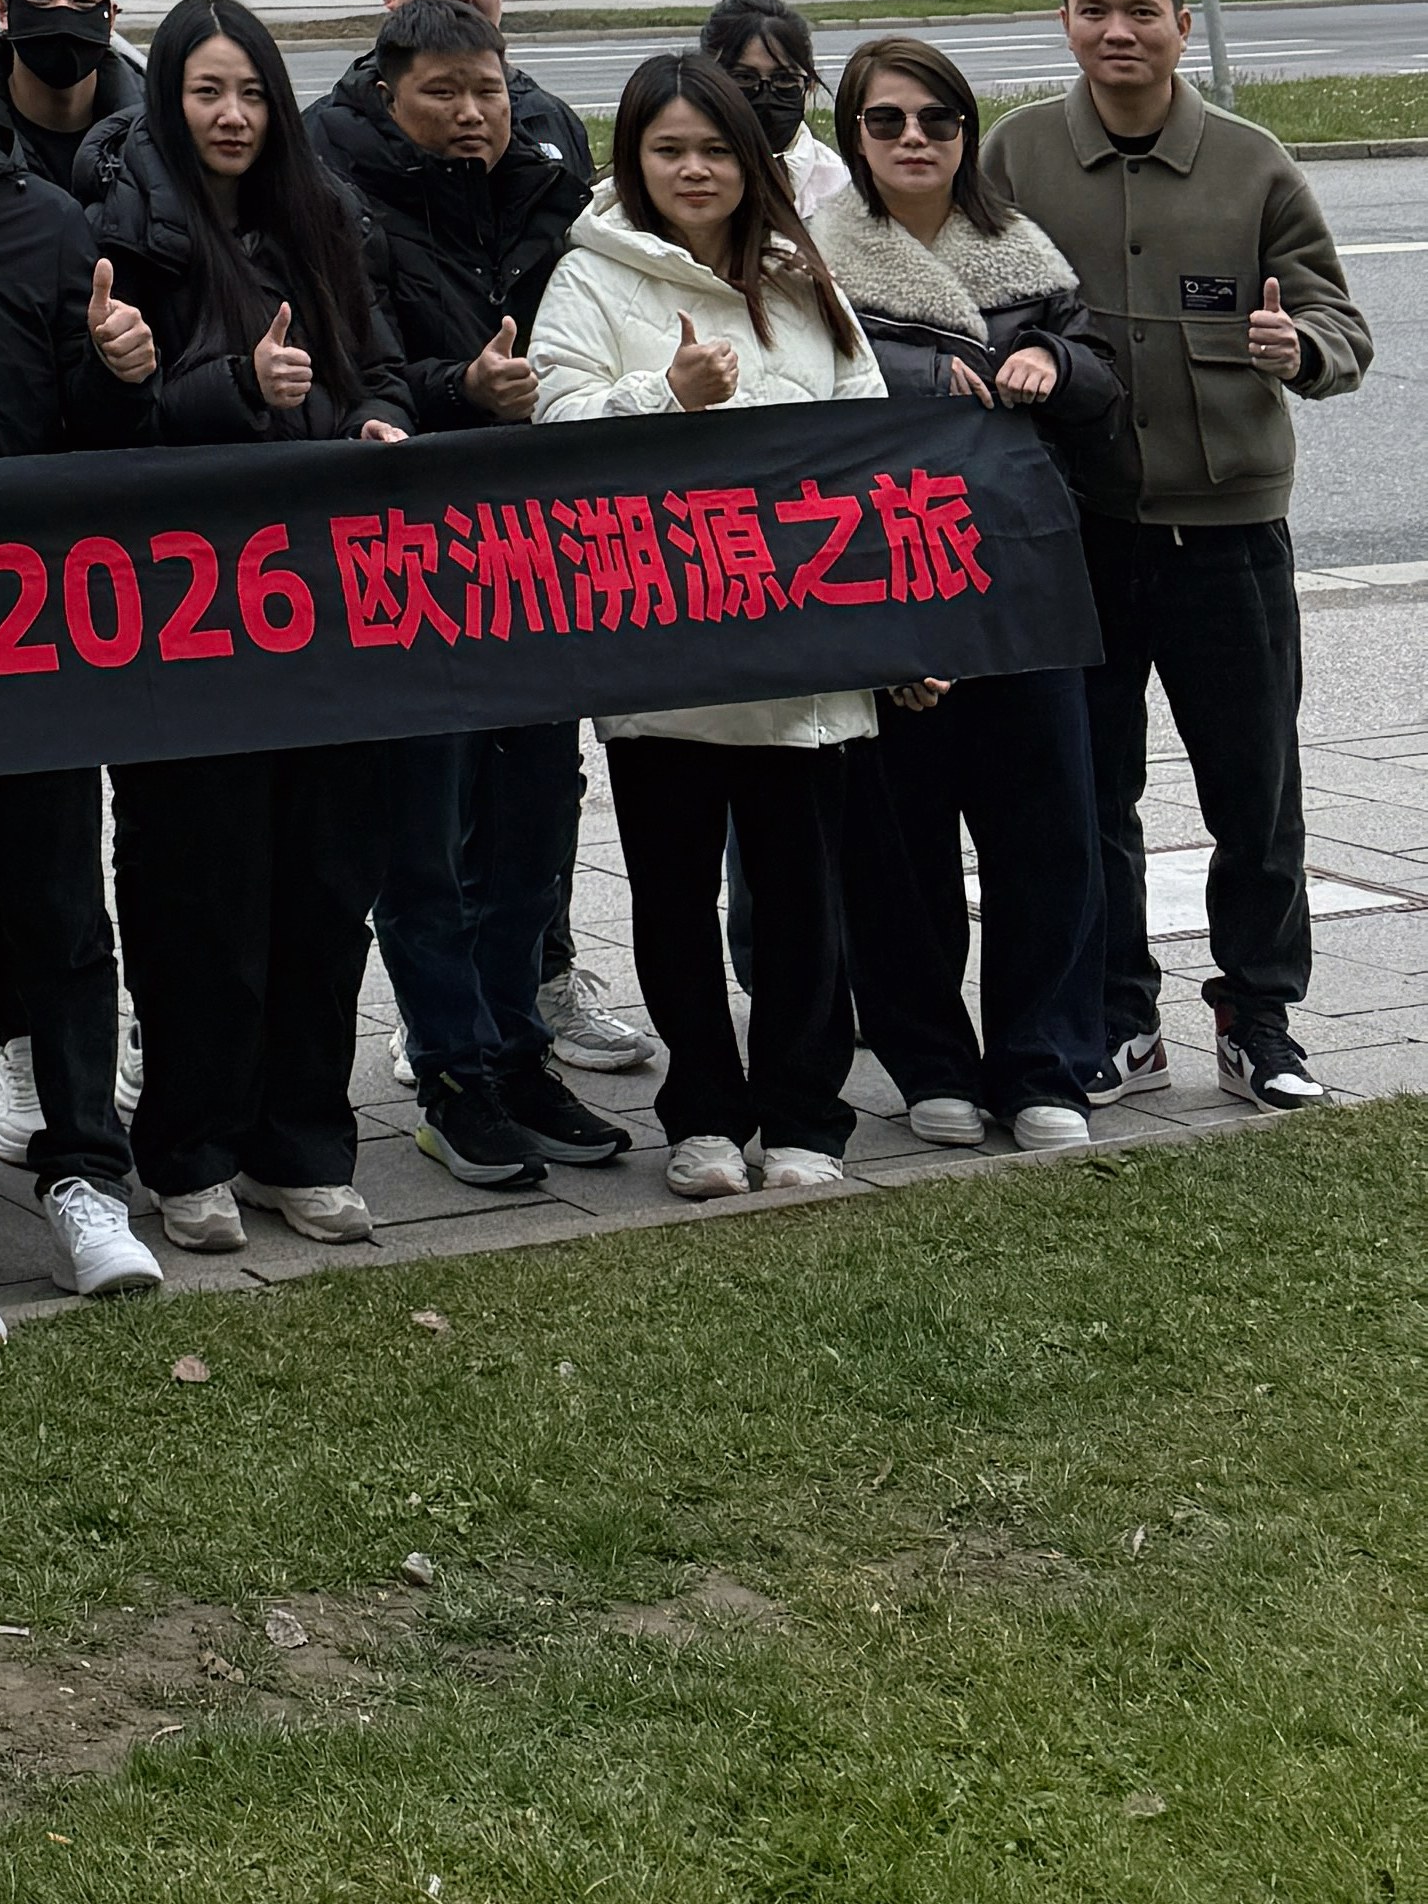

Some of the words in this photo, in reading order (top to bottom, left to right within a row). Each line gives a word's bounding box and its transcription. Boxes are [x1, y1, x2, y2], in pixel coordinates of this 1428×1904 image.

[330, 467, 992, 649] 欧洲溯源之旅
